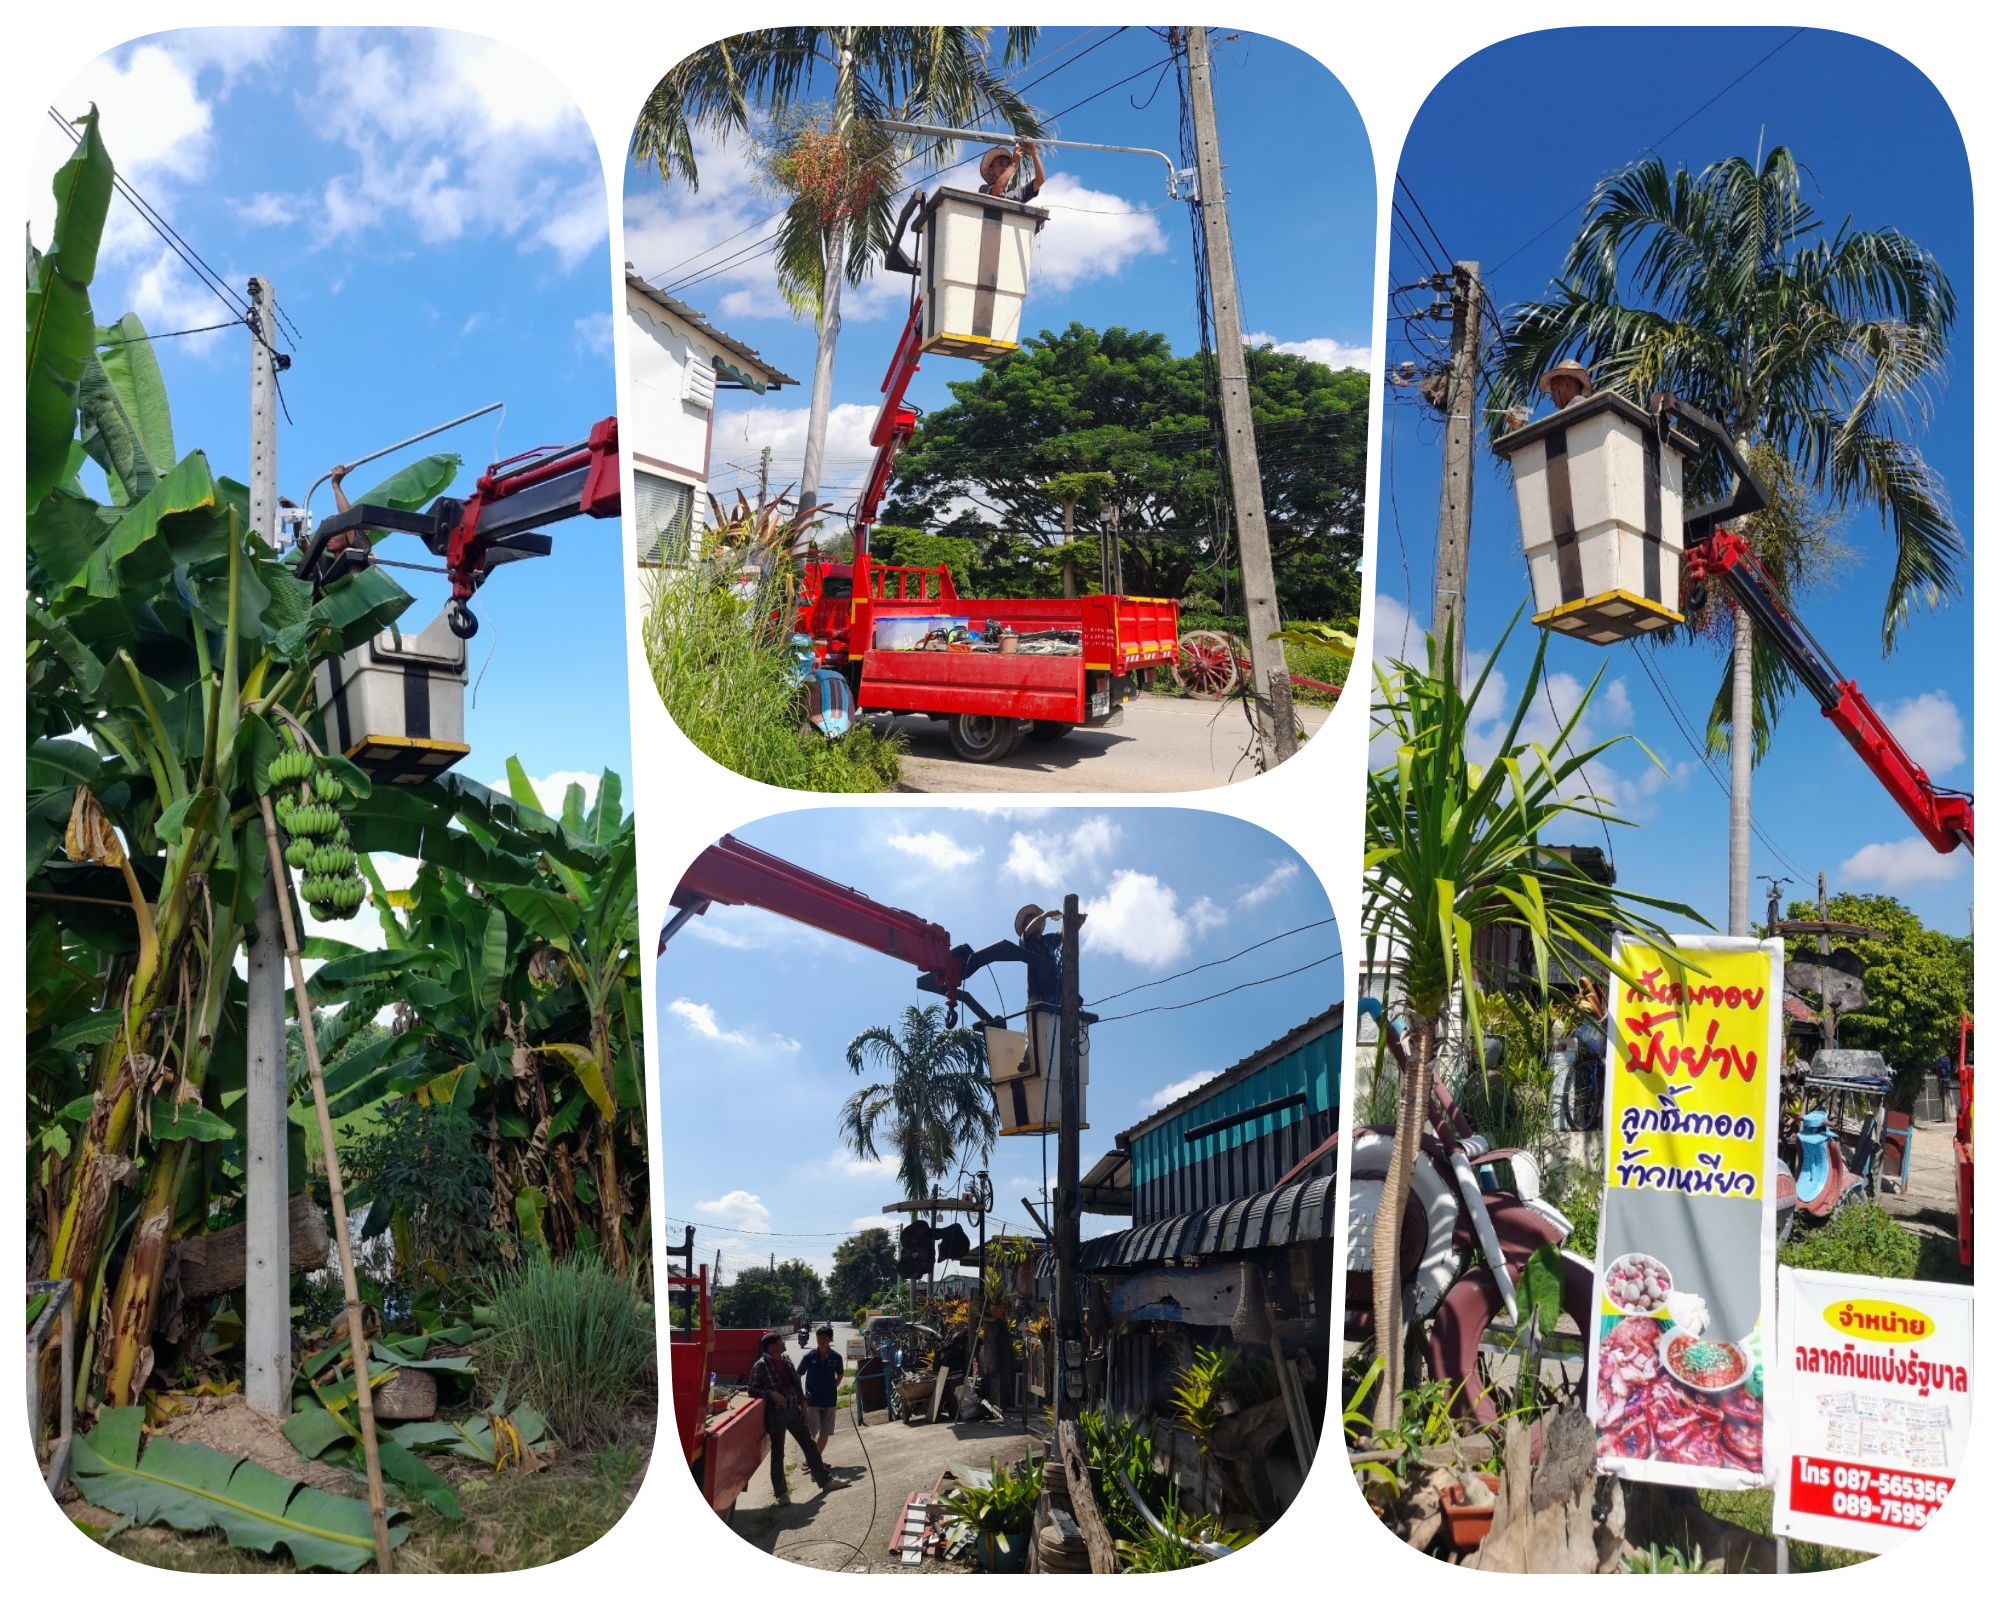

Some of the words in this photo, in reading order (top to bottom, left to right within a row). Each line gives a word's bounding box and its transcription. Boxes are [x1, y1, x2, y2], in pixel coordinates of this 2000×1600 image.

[1625, 1011, 1758, 1082] ปิ้งย่าง
[1621, 1085, 1755, 1144] ลูกชิ้นทอด
[1616, 1149, 1756, 1196] ข้าวเหนียว
[1839, 1304, 1925, 1336] จำหน่าย
[1799, 1457, 1831, 1486] โทร
